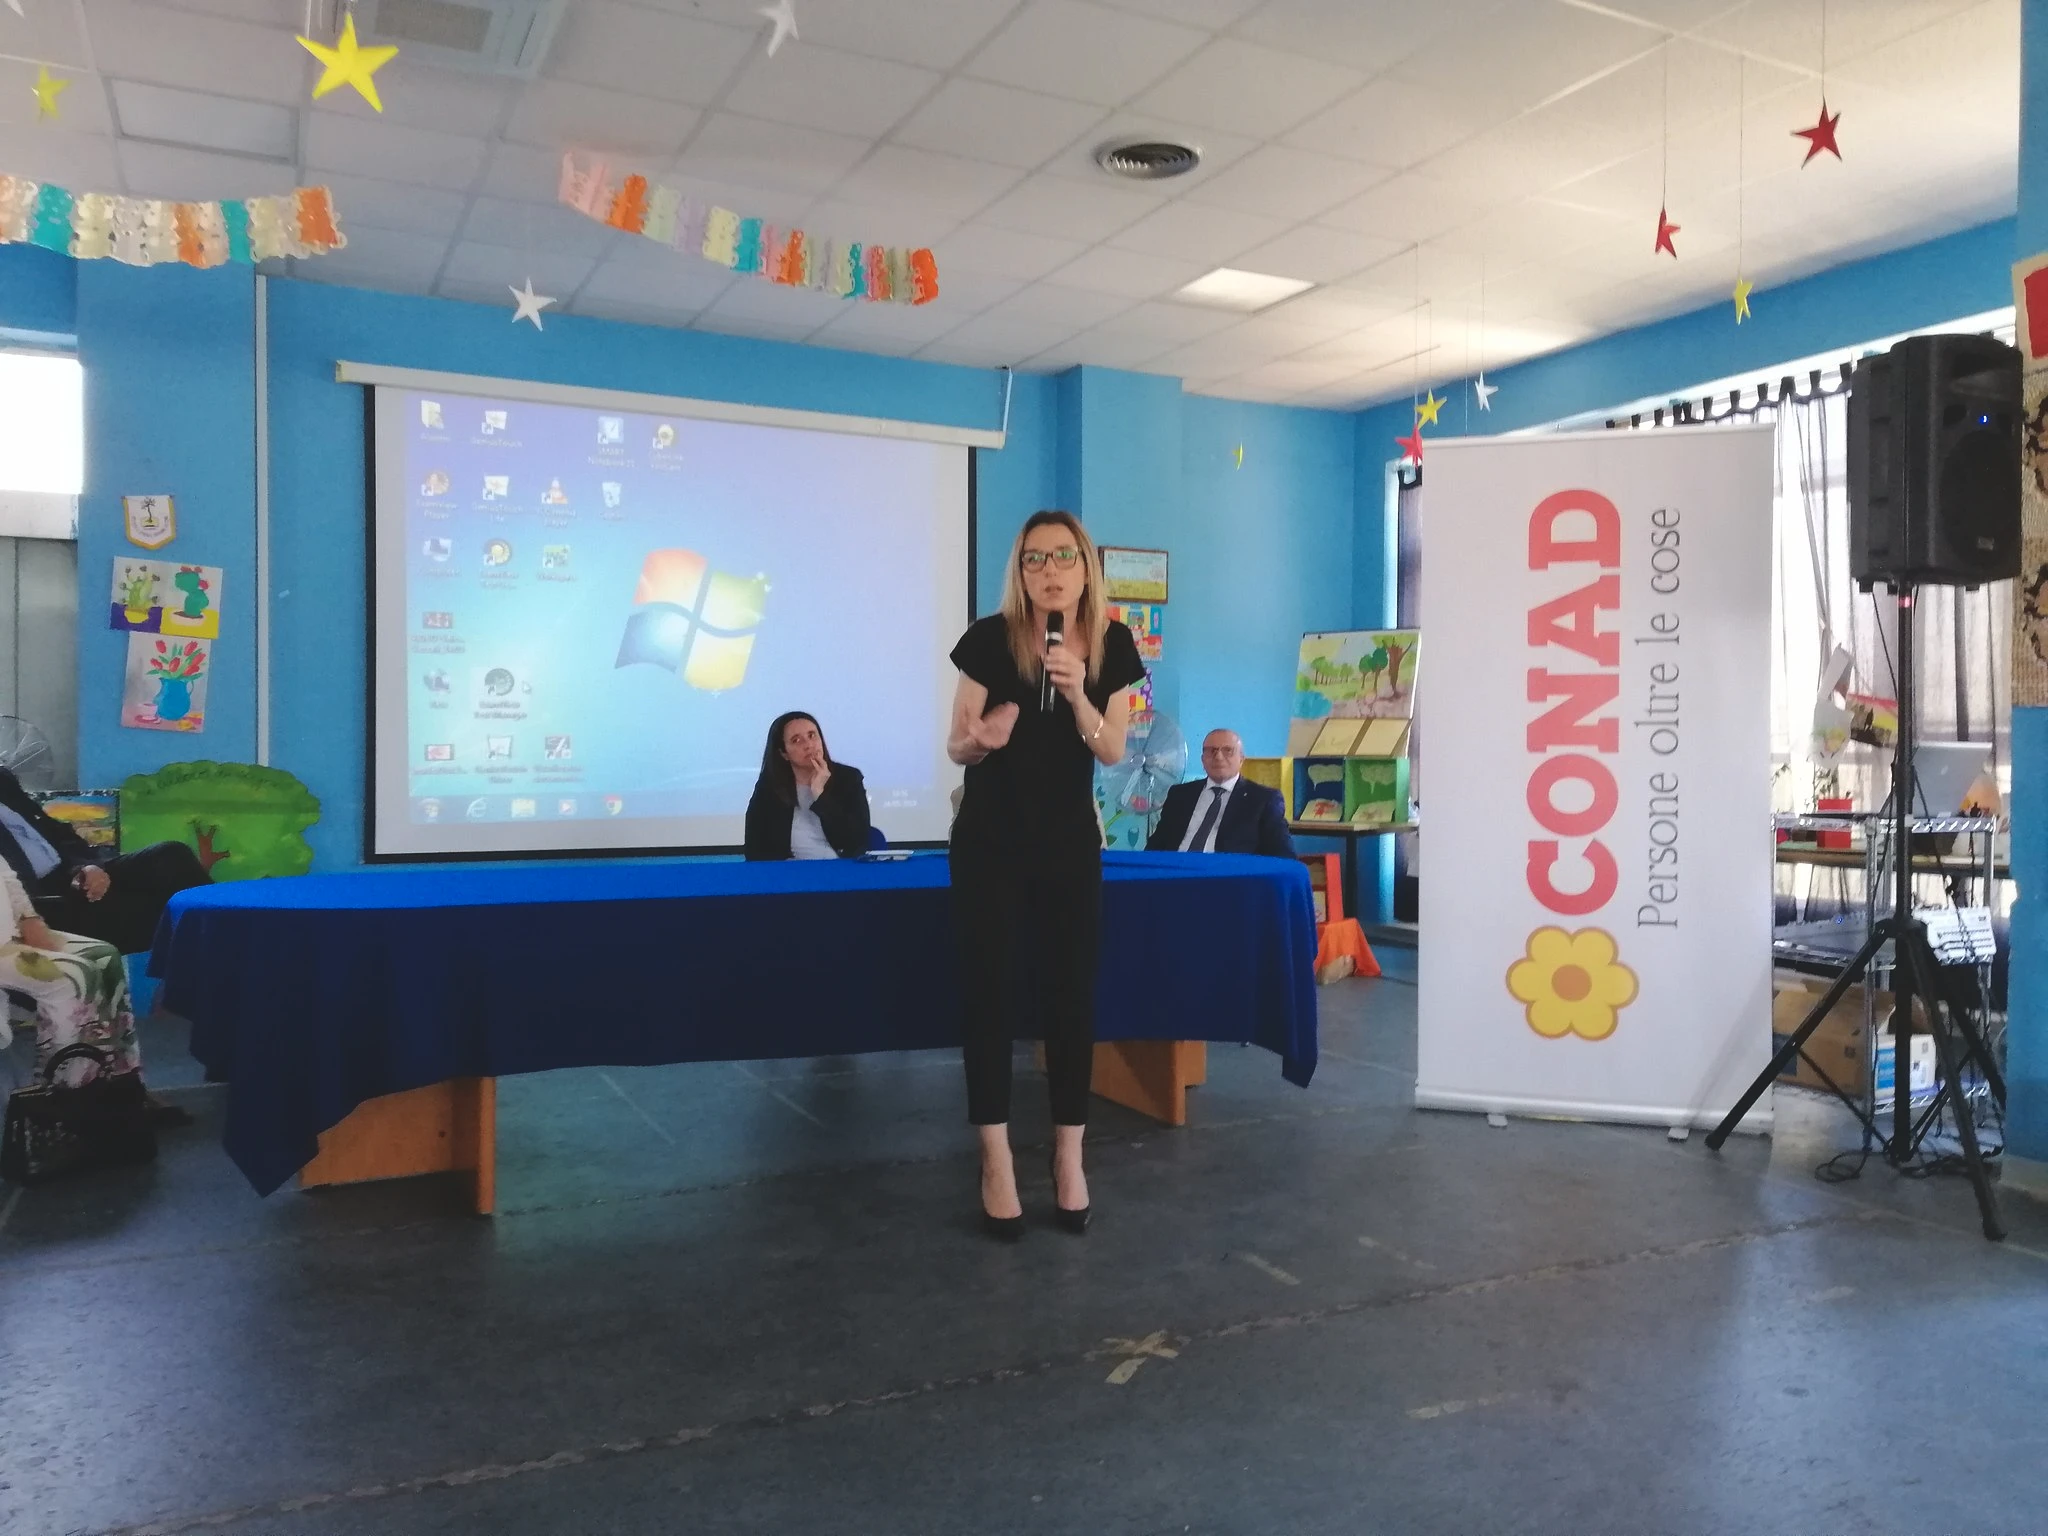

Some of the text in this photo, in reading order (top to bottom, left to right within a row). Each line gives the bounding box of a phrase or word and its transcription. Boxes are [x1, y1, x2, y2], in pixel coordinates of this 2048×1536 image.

[1526, 489, 1620, 915] CONAD
[1634, 508, 1681, 929] Persone oltre le cose
